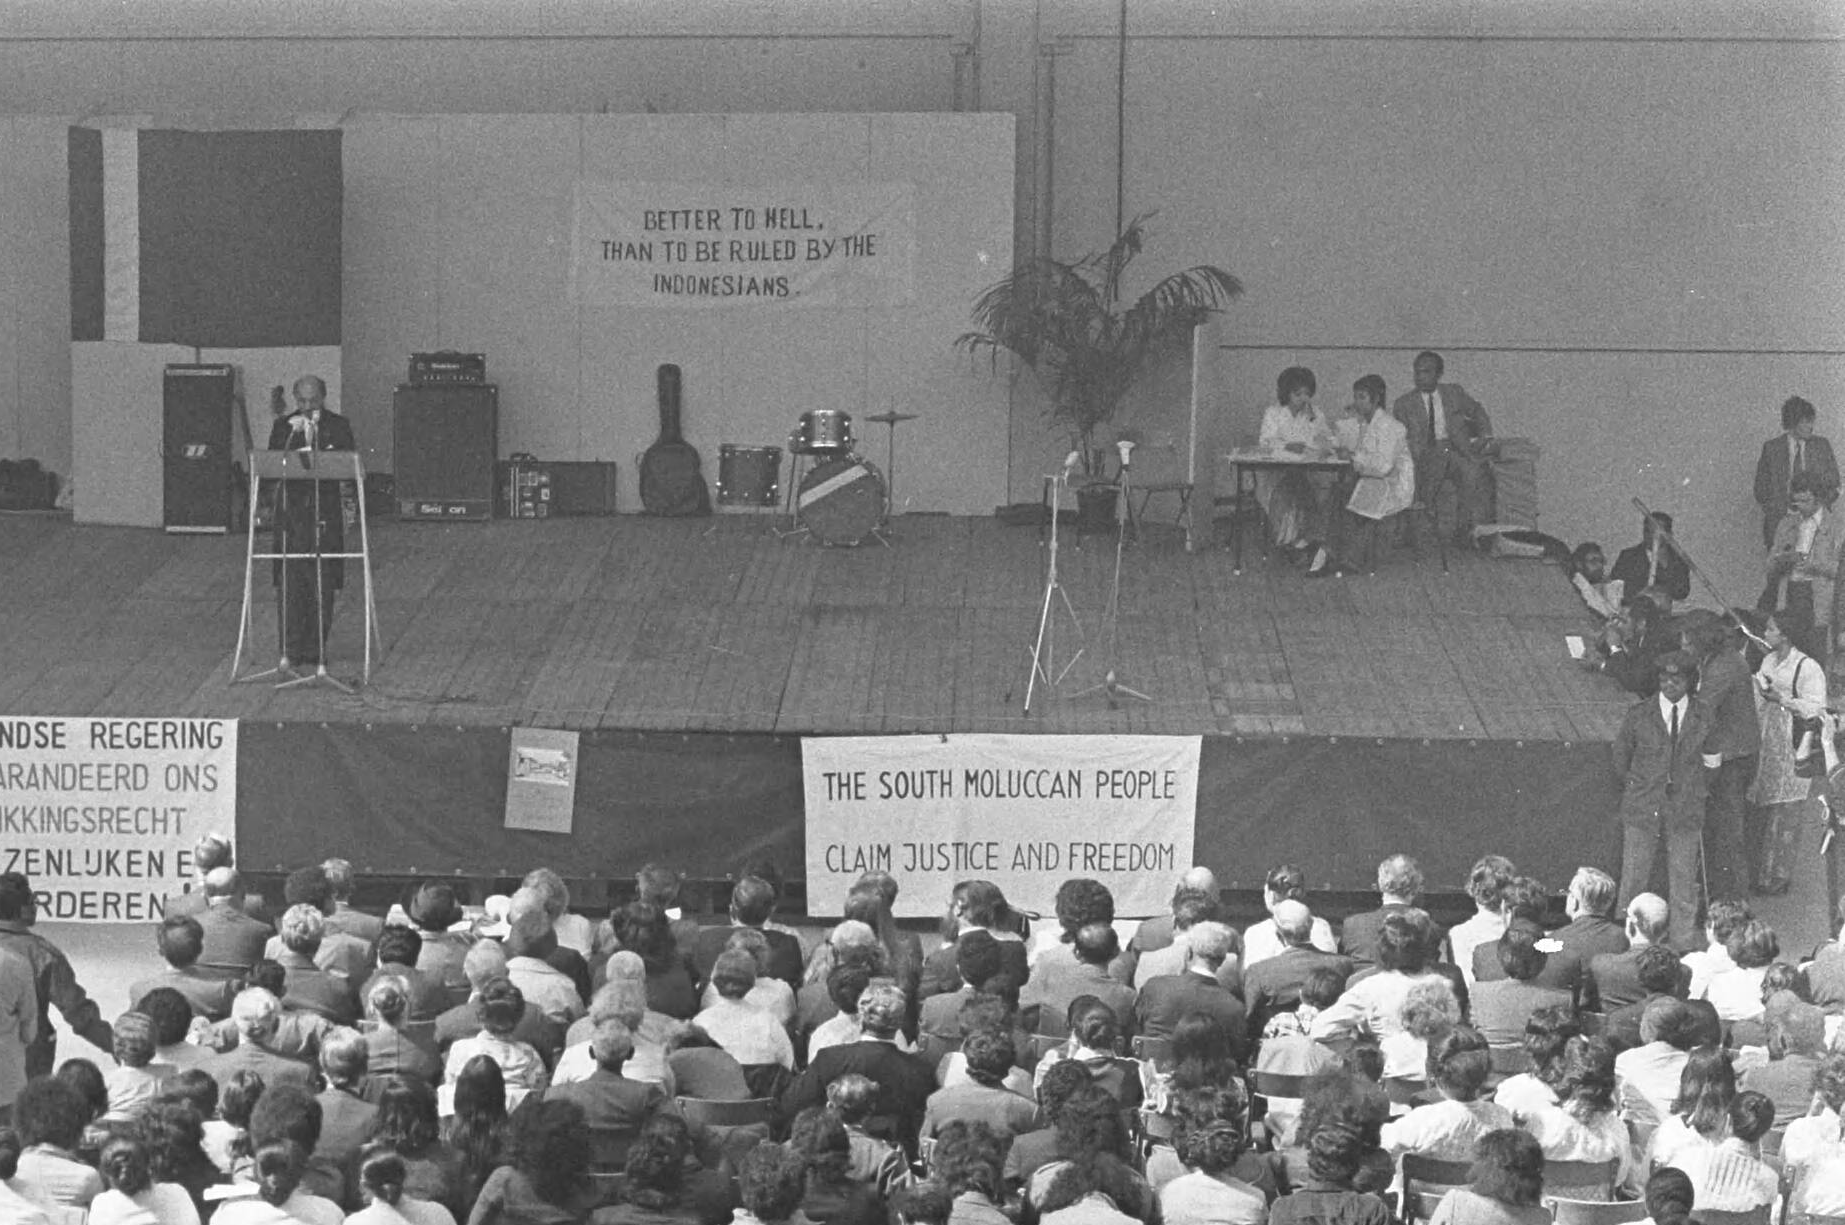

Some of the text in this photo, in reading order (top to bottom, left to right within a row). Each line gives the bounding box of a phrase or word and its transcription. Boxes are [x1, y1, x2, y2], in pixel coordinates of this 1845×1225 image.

[644, 207, 824, 231] BETTER TO HELL,
[602, 233, 877, 263] THAN TO BE RULED BY THE
[653, 273, 801, 297] INDONESIANS.
[91, 721, 223, 750] REGERING
[164, 764, 218, 793] ONS
[822, 769, 1176, 801] THE SOUTH MOLUCCAN PEOPLE
[825, 843, 1175, 872] CLAIM JUSTICE AND FREEDOM
